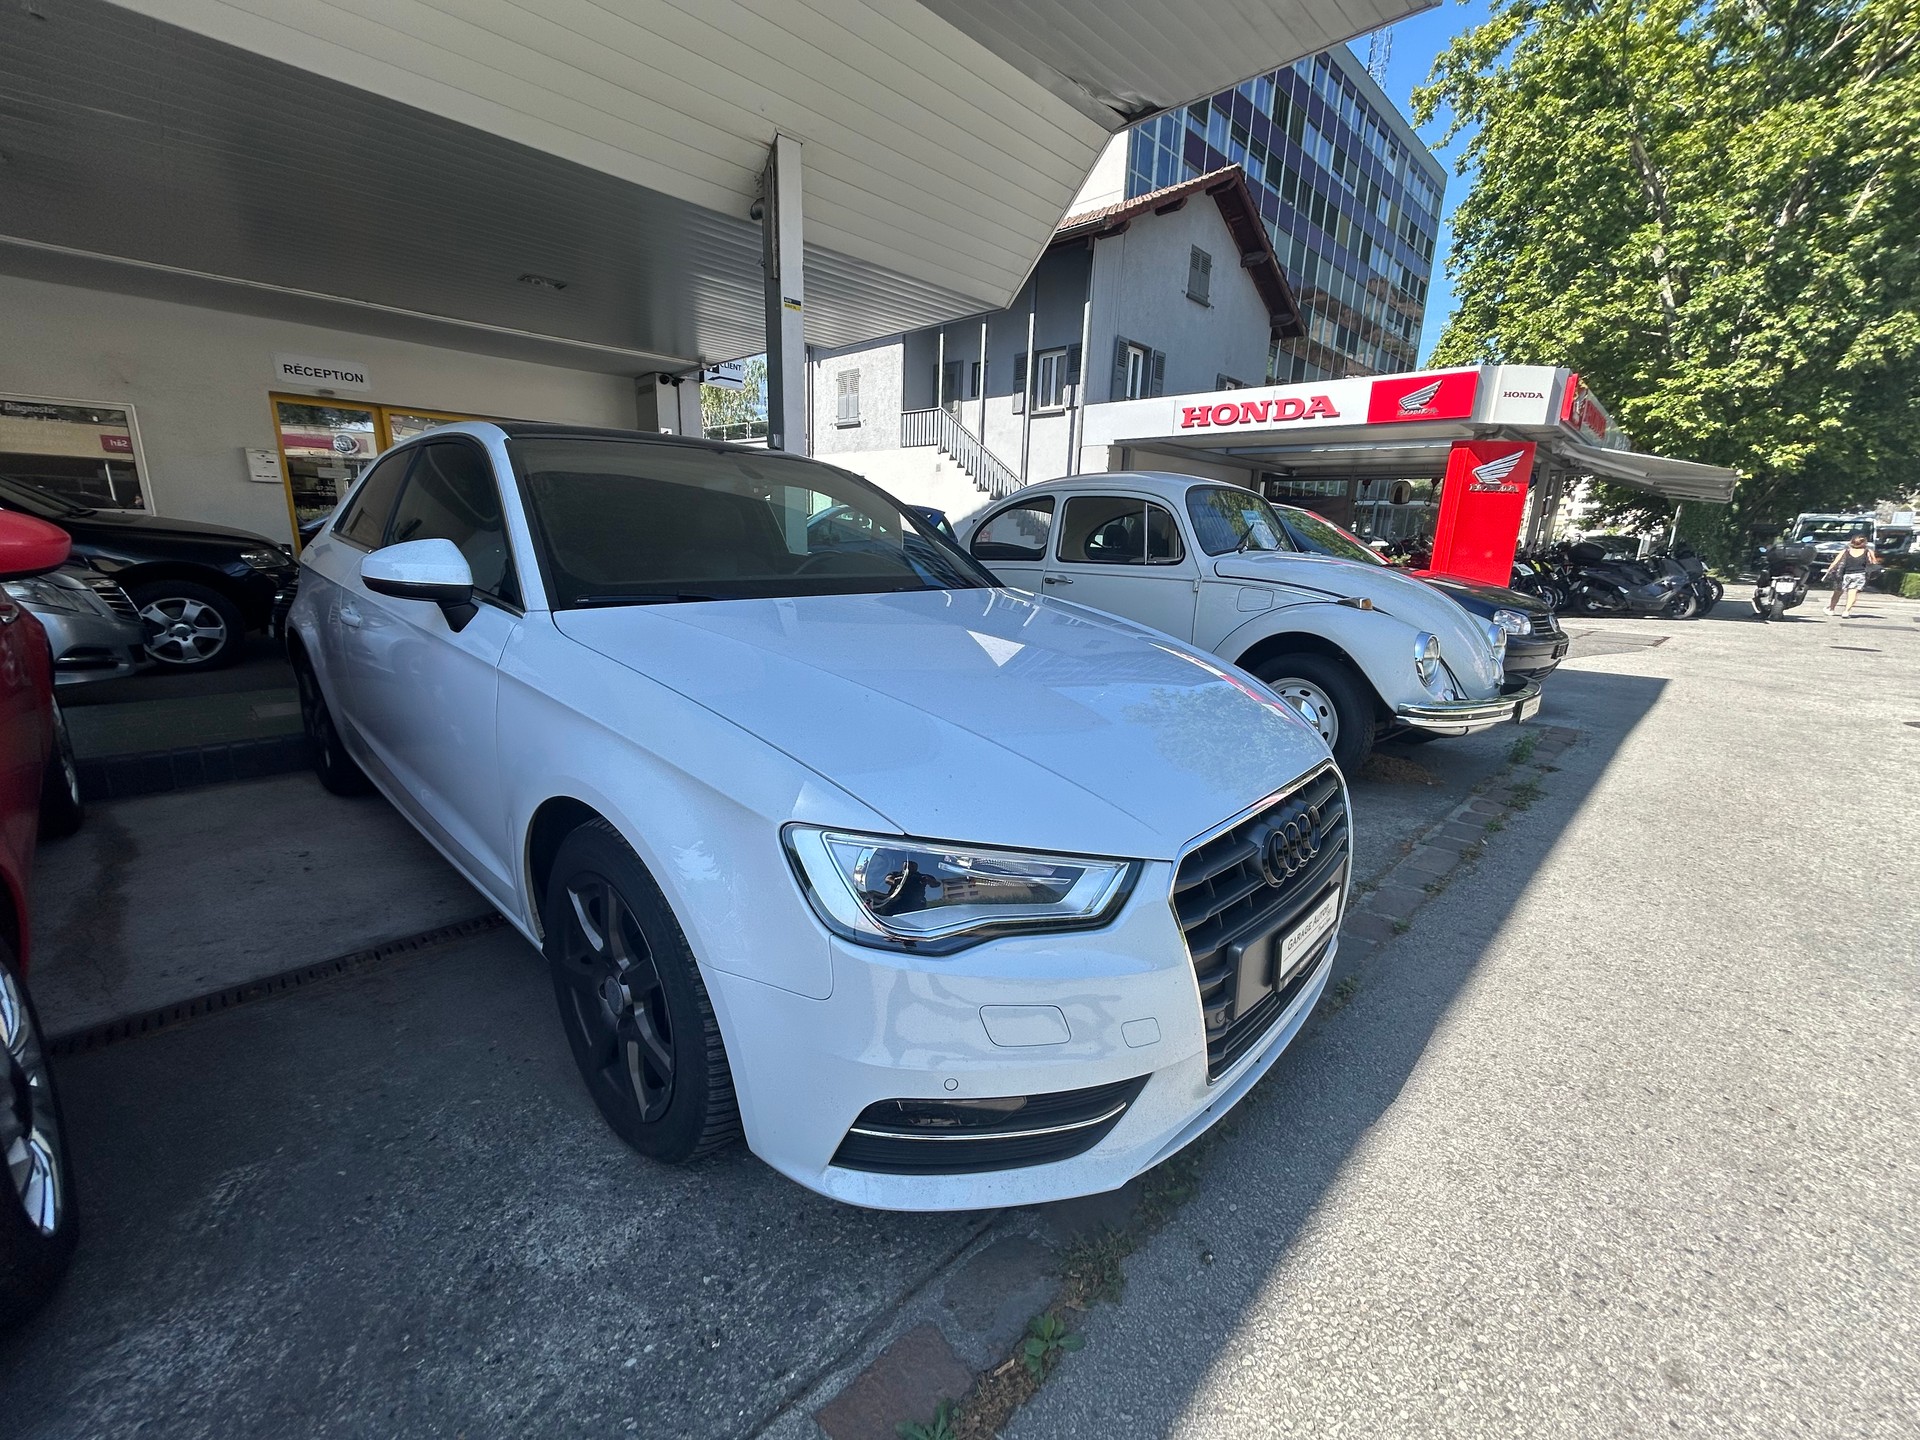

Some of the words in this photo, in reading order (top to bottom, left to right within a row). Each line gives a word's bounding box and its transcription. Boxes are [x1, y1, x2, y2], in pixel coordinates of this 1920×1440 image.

[283, 363, 364, 383] RÉCEPTION
[1503, 391, 1544, 399] HONDA
[4, 402, 57, 414] Diagnostic
[1181, 395, 1341, 428] HONDA
[1287, 922, 1313, 951] GARAGE
